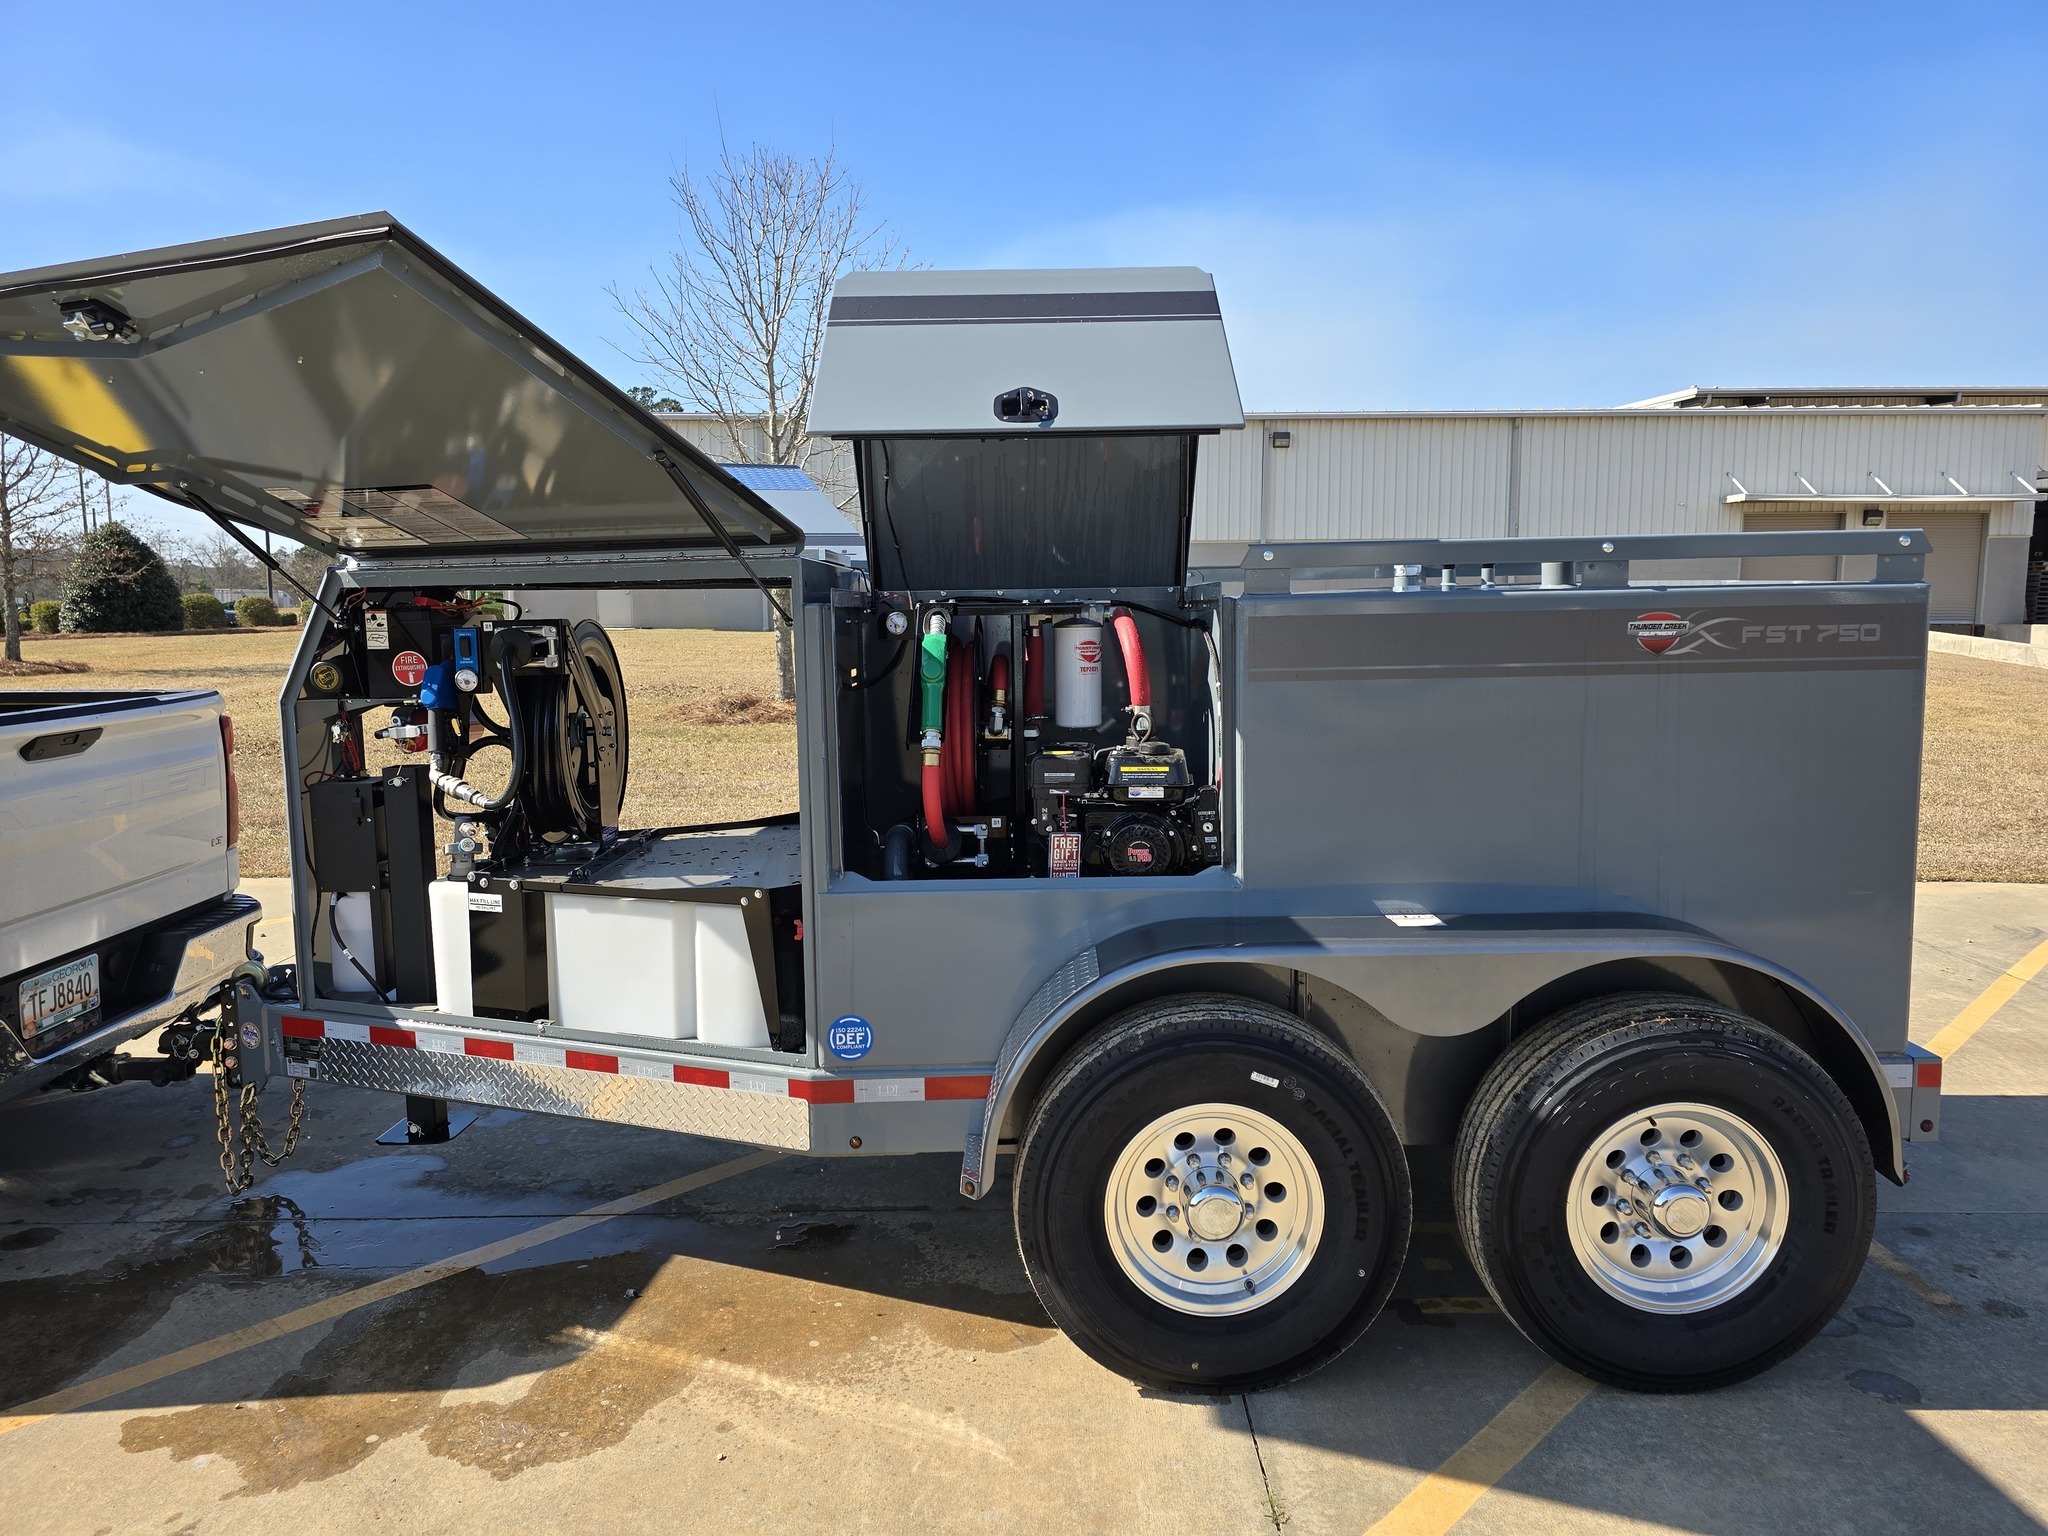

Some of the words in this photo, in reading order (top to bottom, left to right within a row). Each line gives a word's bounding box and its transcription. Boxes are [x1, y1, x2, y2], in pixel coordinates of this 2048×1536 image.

[1663, 622, 1688, 630] CREEK
[1742, 625, 1810, 643] FST
[1817, 624, 1881, 642] 750
[400, 656, 418, 664] FIRE
[1054, 837, 1078, 848] FREE
[1053, 848, 1078, 859] GIFT
[1137, 854, 1152, 862] PRO
[52, 959, 93, 981] GEORGIA
[29, 972, 92, 1020] TFJ8840
[836, 1033, 865, 1045] DEF
[1347, 1160, 1370, 1242] TRAILER
[1816, 1157, 1839, 1235] TRAILER
